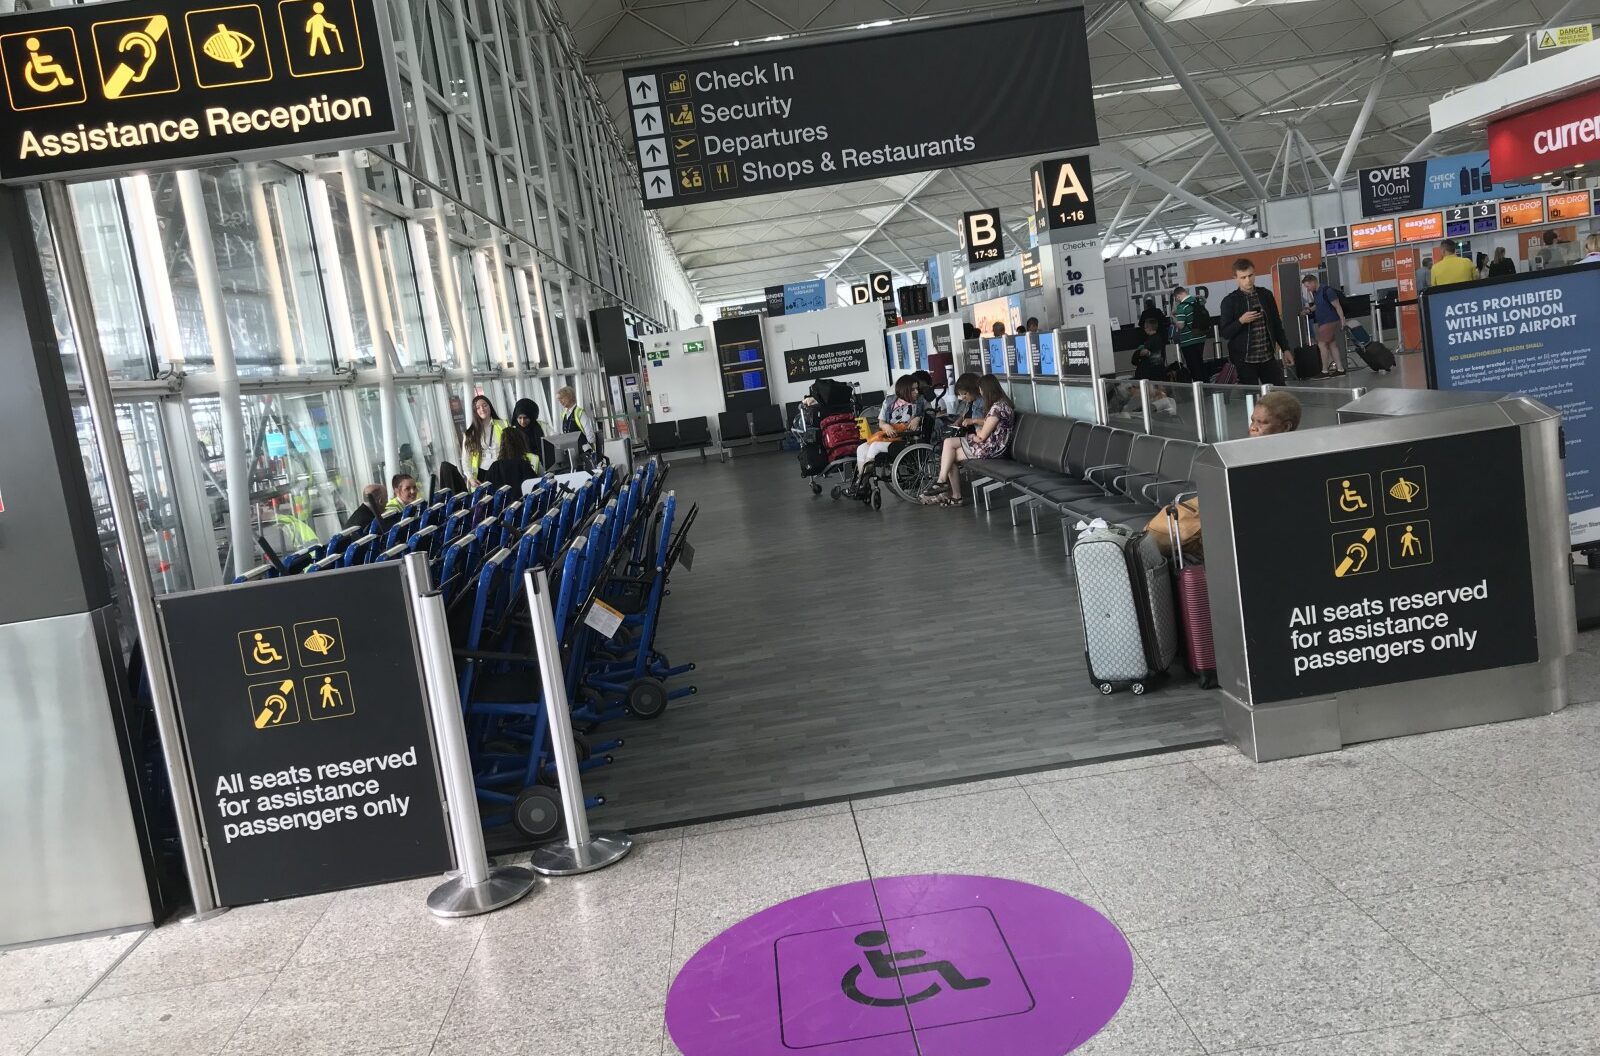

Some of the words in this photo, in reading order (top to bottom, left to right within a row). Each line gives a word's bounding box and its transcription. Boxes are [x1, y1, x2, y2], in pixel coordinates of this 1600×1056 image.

[1560, 26, 1588, 35] DANGER
[695, 65, 768, 92] Check
[774, 62, 795, 82] In
[700, 96, 792, 124] Security
[19, 116, 199, 160] Assistance
[205, 93, 373, 137] Reception
[704, 125, 828, 156] Departures
[742, 158, 814, 182] Shops
[820, 152, 836, 172] &
[841, 134, 976, 169] Restaurants
[1369, 166, 1411, 183] OVER
[1429, 173, 1455, 183] CHECK
[1034, 170, 1046, 212] A
[1052, 163, 1089, 206] A
[1372, 179, 1410, 198] 100ml
[1433, 182, 1441, 190] IT
[1443, 181, 1452, 189] IN
[1501, 204, 1518, 214] BAG
[1519, 201, 1541, 212] DROP
[1548, 197, 1565, 207] BAG
[1566, 194, 1588, 204] DROP
[1060, 210, 1085, 223] 1-16
[1454, 209, 1461, 219] 2
[1481, 205, 1488, 216] 3
[969, 213, 997, 247] B
[1353, 223, 1393, 237] easyJet
[1405, 217, 1436, 229] easyJet
[1333, 227, 1338, 237] 1
[974, 248, 998, 260] 17-32
[1062, 240, 1097, 251] Check-in
[1064, 255, 1072, 267] 1
[1066, 269, 1082, 281] to
[1130, 263, 1179, 294] HERE
[873, 274, 890, 294] C
[1067, 283, 1084, 296] 16
[766, 292, 784, 300] UNDER
[854, 286, 869, 304] D
[1445, 301, 1478, 317] ACTS
[1483, 288, 1562, 311] PROHIBITED
[1446, 313, 1498, 330] WITHIN
[1503, 302, 1563, 322] LONDON
[1448, 326, 1515, 345] STANSTED
[1520, 314, 1577, 334] AIRPORT
[836, 346, 864, 356] reserved
[810, 361, 846, 373] passengers
[819, 355, 853, 365] assistance
[1289, 605, 1317, 628] All
[1323, 598, 1384, 623] seats
[1389, 579, 1488, 613] reserved
[1290, 629, 1322, 650] for
[1328, 612, 1449, 644] assistance
[1294, 637, 1425, 676] passengers
[1430, 627, 1478, 651] only
[215, 773, 244, 796] All
[249, 765, 312, 790] seats
[317, 746, 418, 781] reserved
[218, 797, 251, 818] for
[257, 779, 380, 812] assistance
[223, 803, 358, 844] passengers
[363, 793, 410, 817] only
